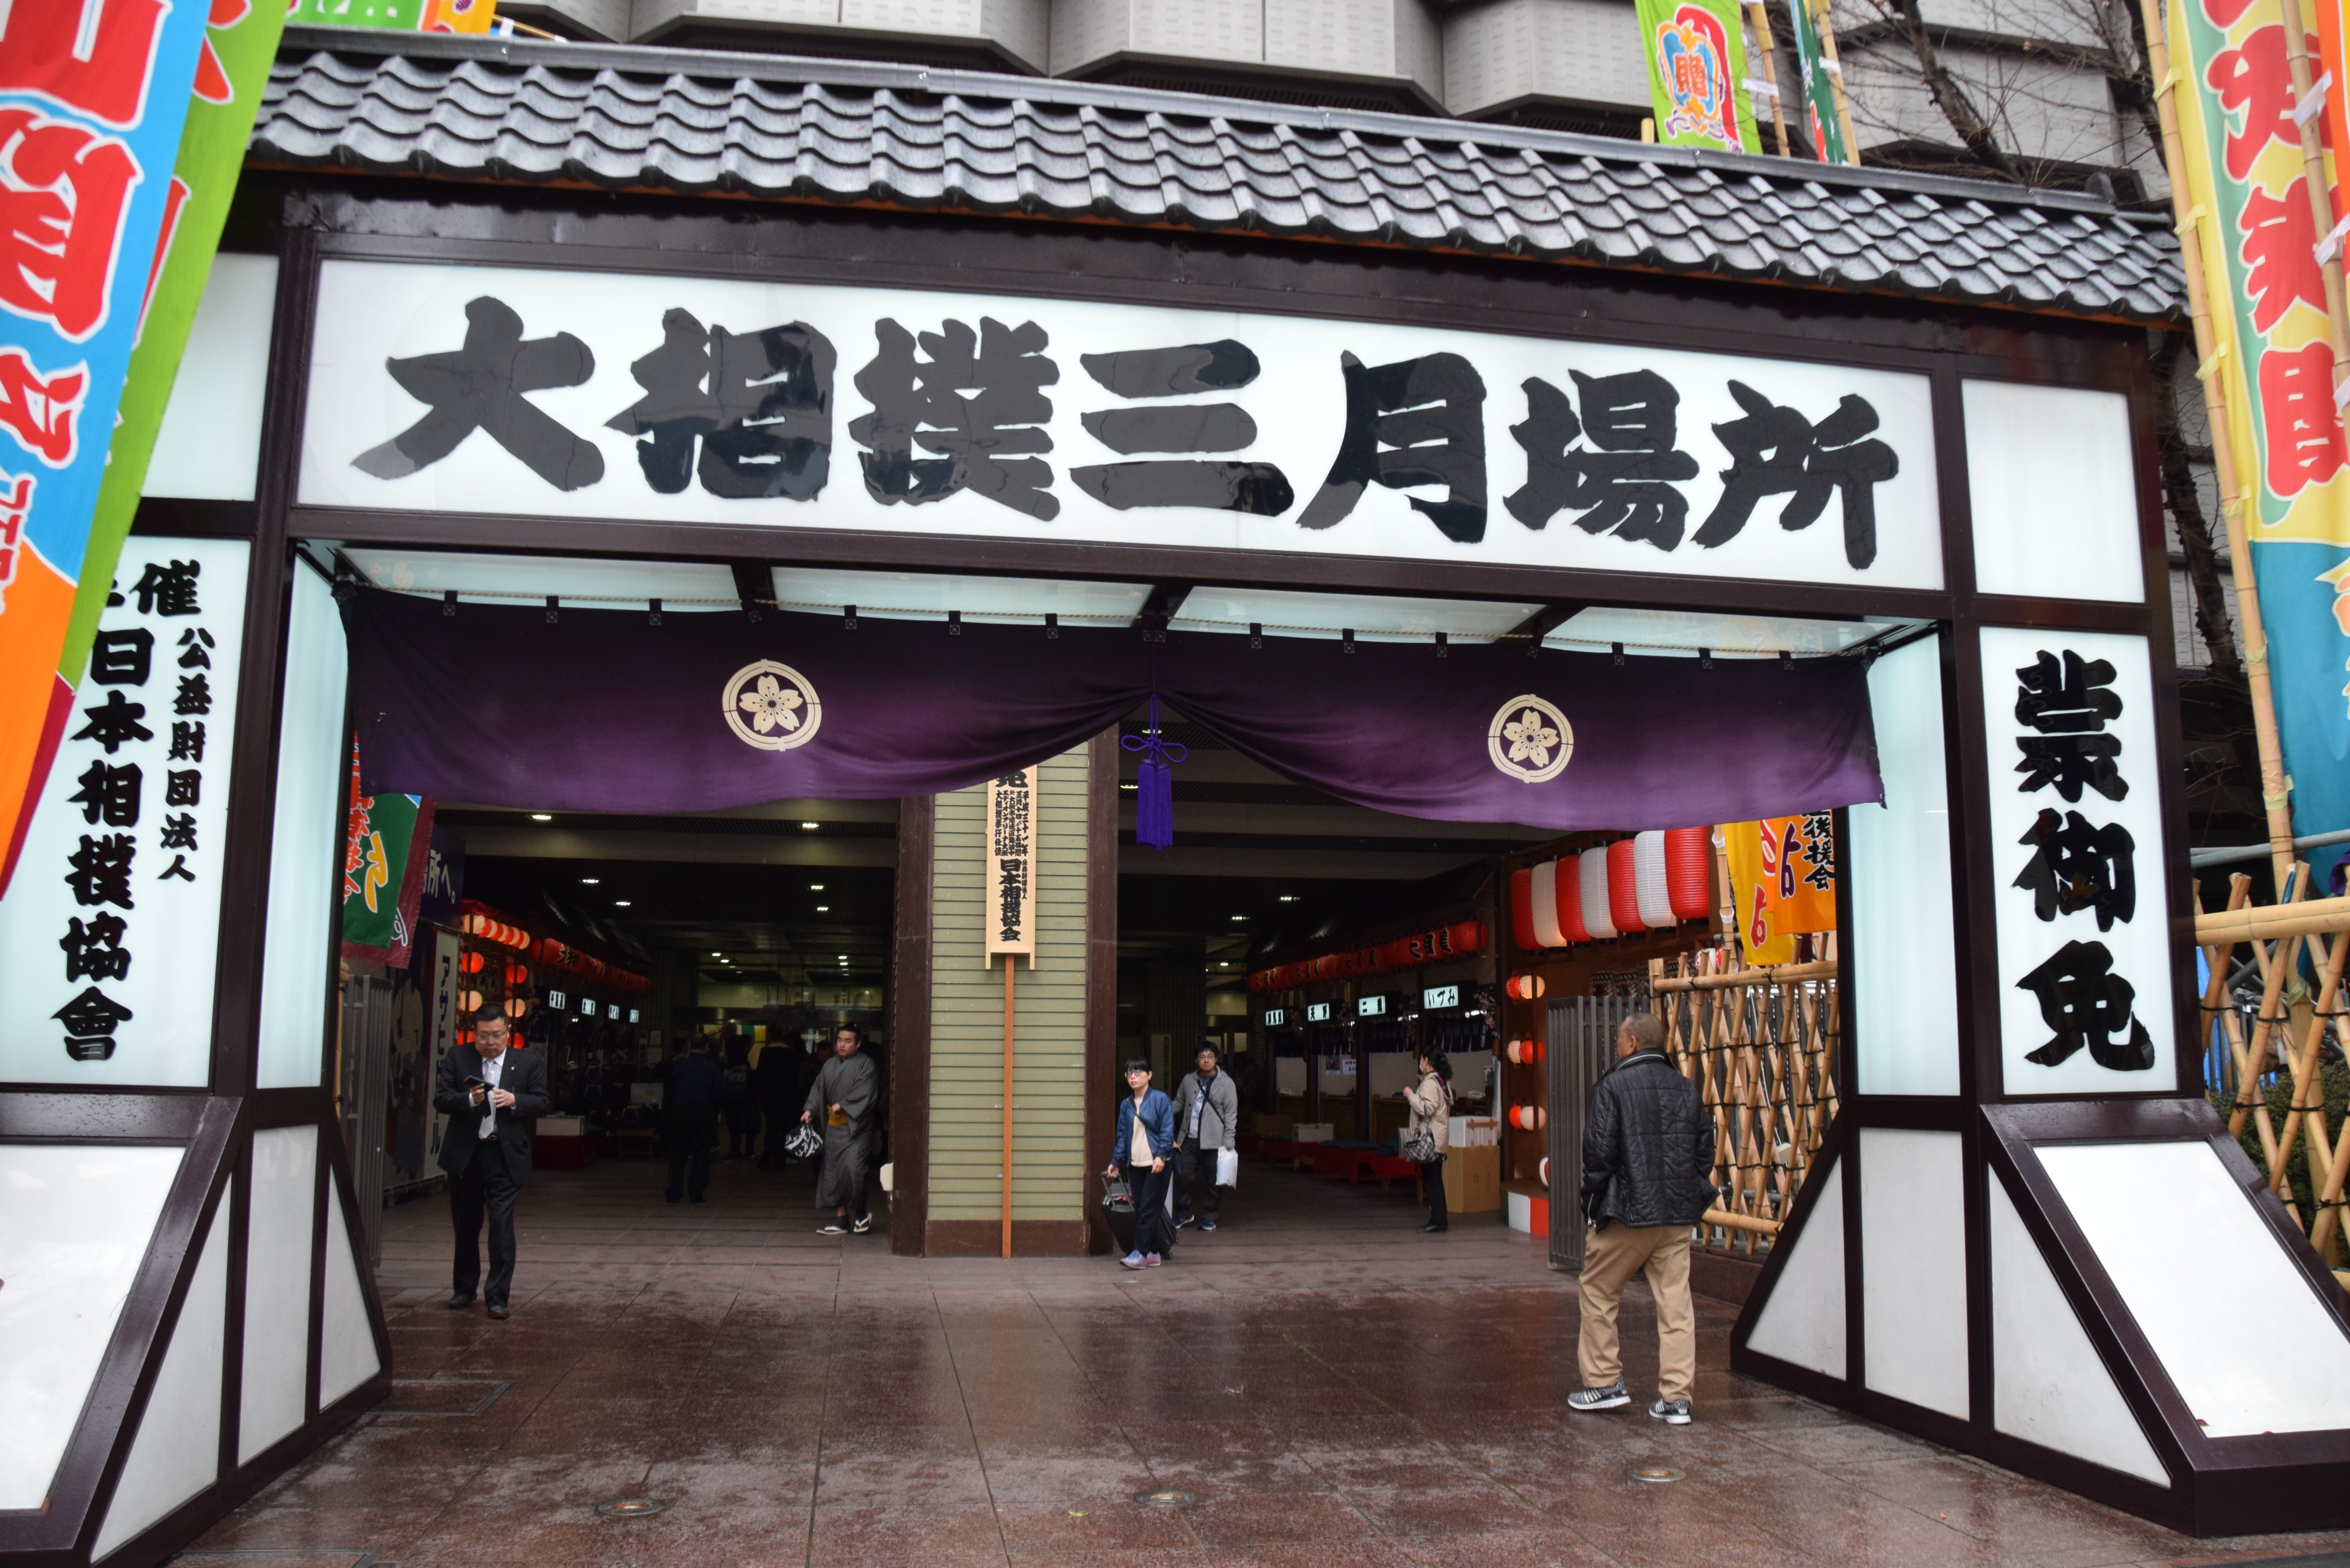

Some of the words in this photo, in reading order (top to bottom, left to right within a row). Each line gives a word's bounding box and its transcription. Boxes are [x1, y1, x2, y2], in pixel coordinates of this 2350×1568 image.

[350, 296, 1898, 571] 大相撲三月場所
[158, 627, 215, 882] 公益財団法人
[1801, 808, 1835, 891] 後援会
[998, 858, 1022, 942] 日本相撲協会
[1428, 988, 1456, 1008] いづみ
